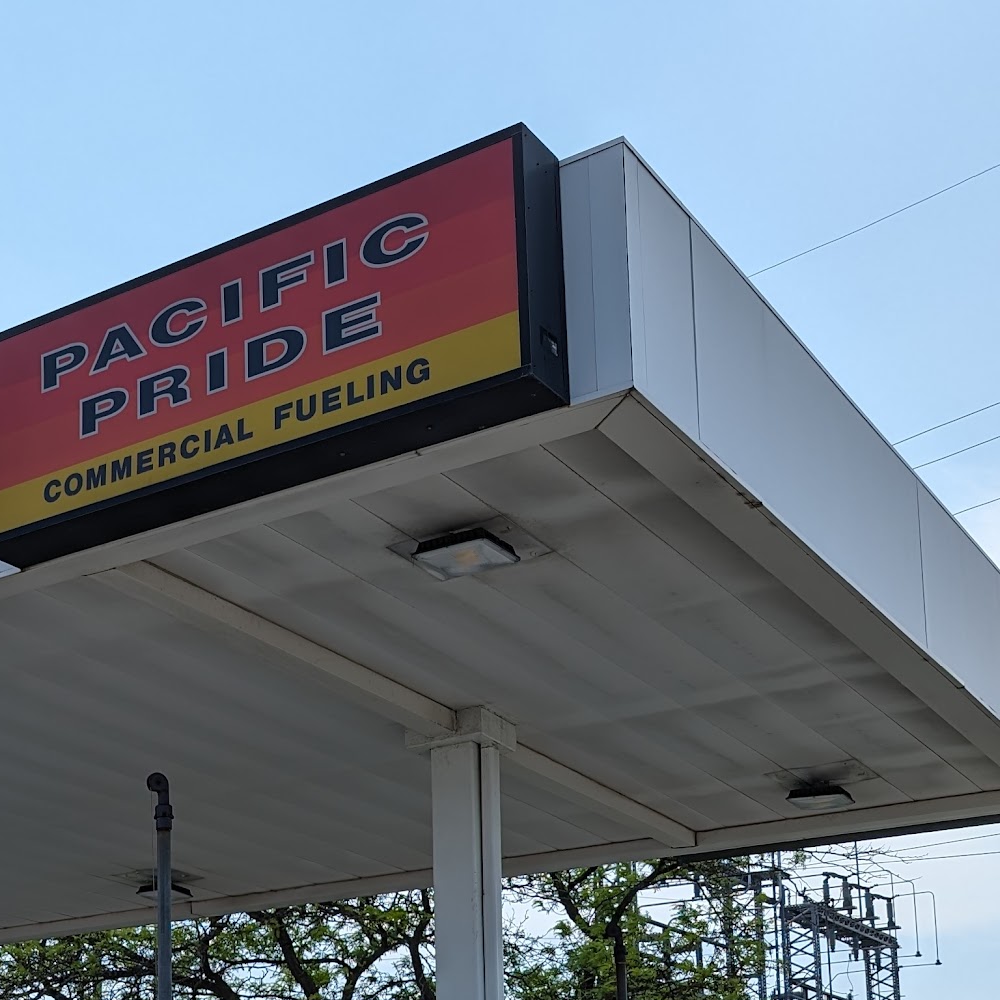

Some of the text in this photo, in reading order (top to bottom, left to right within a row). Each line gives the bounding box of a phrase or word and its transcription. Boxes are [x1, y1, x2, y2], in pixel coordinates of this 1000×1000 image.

[41, 213, 429, 393] PACIFIC
[80, 291, 382, 439] PRIDE
[43, 357, 431, 503] COMMERCIAL FUELING
